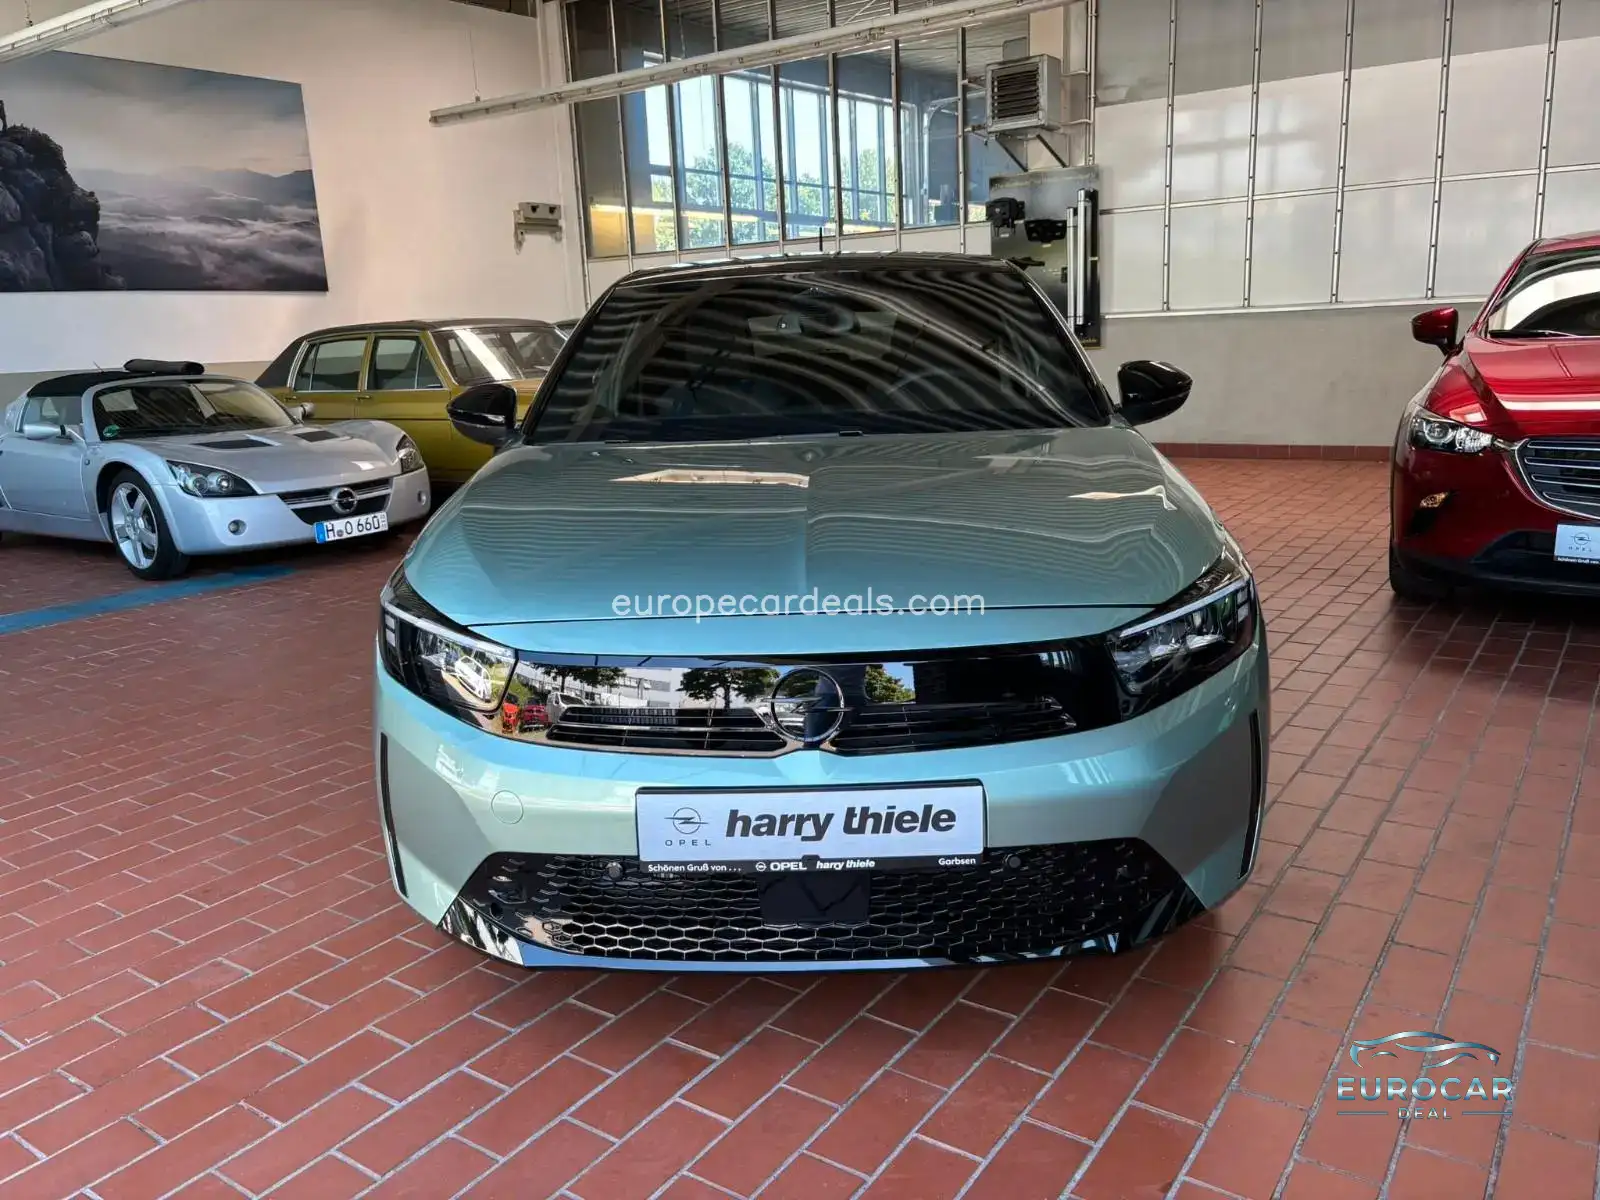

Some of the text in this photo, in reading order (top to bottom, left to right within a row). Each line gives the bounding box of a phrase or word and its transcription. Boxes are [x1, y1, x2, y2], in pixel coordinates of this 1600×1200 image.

[725, 804, 957, 842] harry thiele
[664, 838, 712, 847] OPEL
[770, 859, 876, 871] OPEL harry thiele
[938, 857, 976, 866] Garbsen
[648, 863, 686, 872] Schönen
[687, 863, 709, 872] Gruß
